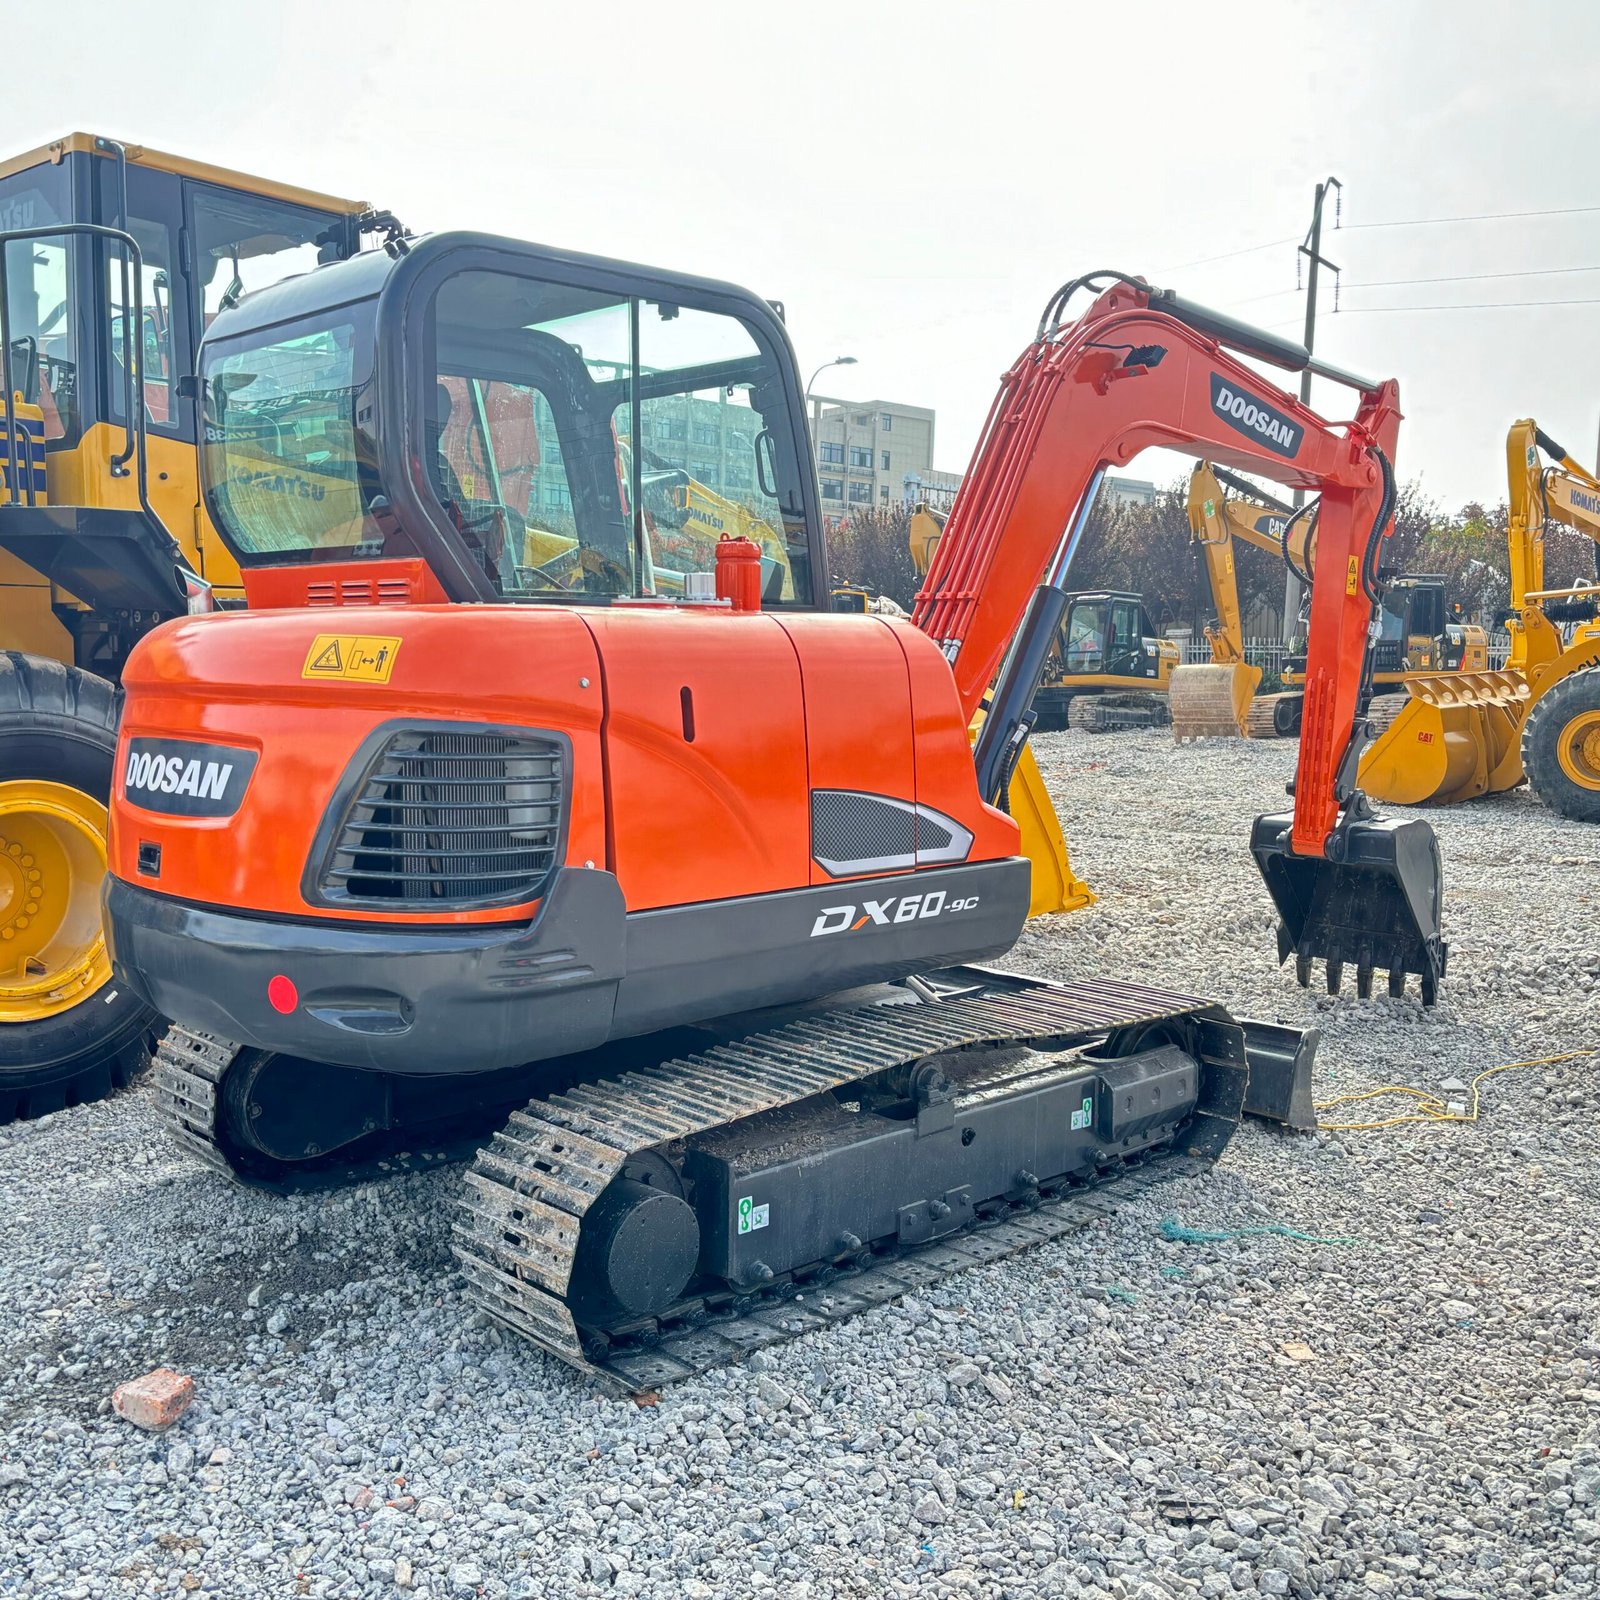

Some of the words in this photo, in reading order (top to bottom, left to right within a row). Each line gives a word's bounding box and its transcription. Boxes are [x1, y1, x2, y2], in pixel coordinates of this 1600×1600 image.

[1216, 387, 1294, 448] DOOSAN
[1418, 732, 1433, 743] CAT
[126, 752, 233, 800] DOOSAN
[810, 891, 979, 937] DX60-9C
